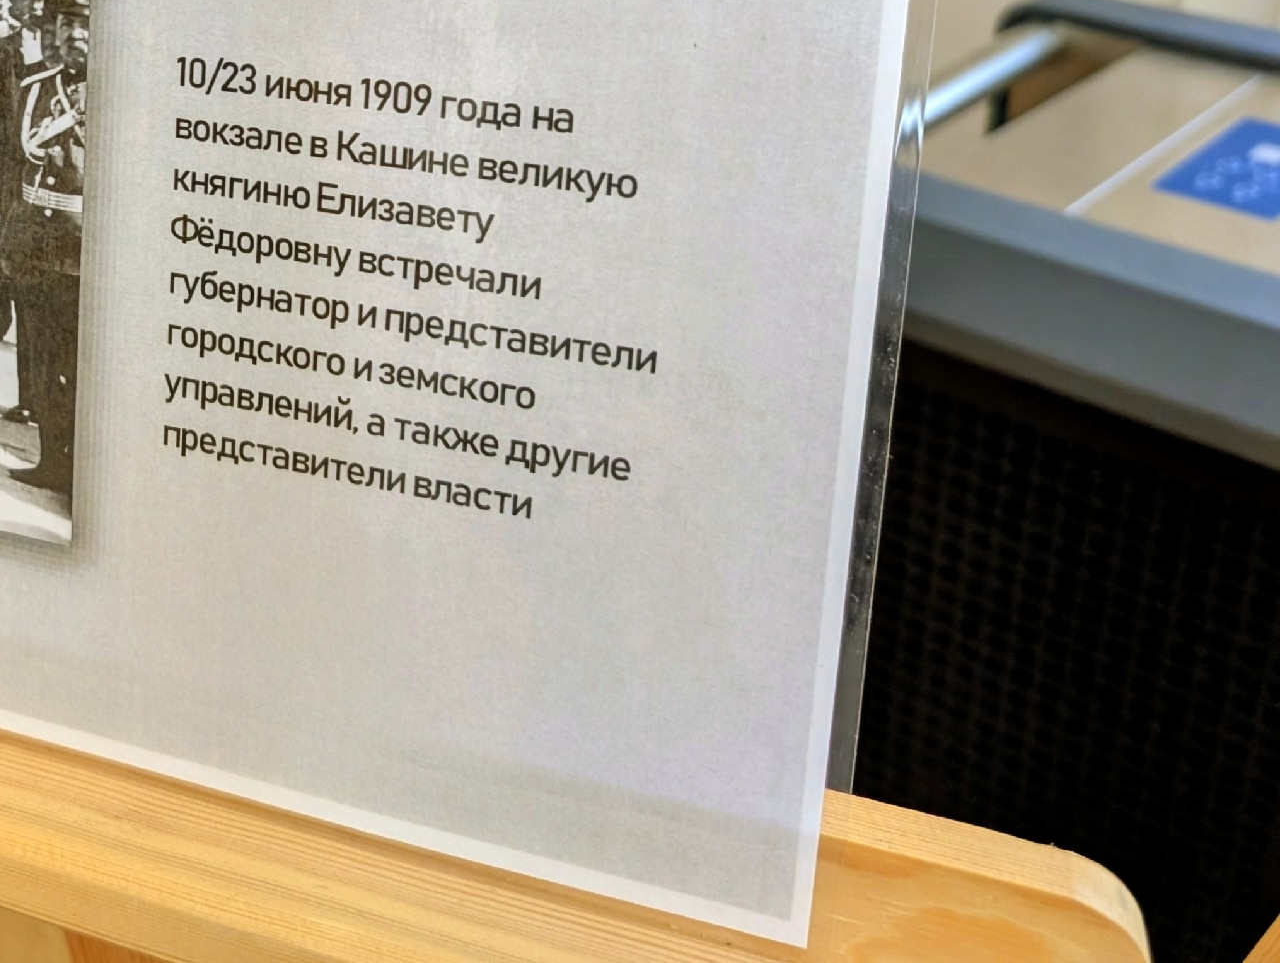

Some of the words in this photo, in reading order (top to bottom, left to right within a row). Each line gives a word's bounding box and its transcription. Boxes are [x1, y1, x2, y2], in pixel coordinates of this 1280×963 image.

[176, 56, 256, 95] 10/23
[265, 72, 352, 107] июня
[360, 78, 432, 116] 1909
[440, 93, 521, 130] года
[532, 106, 574, 133] на
[175, 116, 302, 154] вокзале
[310, 135, 328, 158] в
[336, 130, 469, 177] Кашине
[478, 158, 638, 203] великую
[174, 169, 310, 209] княгиню
[317, 183, 494, 243] Елизавету
[171, 214, 351, 277] Фёдоровну
[359, 249, 542, 300] встречали
[168, 322, 345, 375] городского
[353, 358, 372, 382] и
[379, 362, 536, 409] земского
[170, 270, 349, 328] губернатор
[358, 304, 377, 328] и
[385, 307, 657, 374] представители
[165, 371, 358, 435] управлений,
[367, 415, 385, 436] а
[395, 418, 498, 458] также
[505, 438, 631, 481] другие
[163, 425, 405, 494] представители
[414, 476, 532, 519] власти
